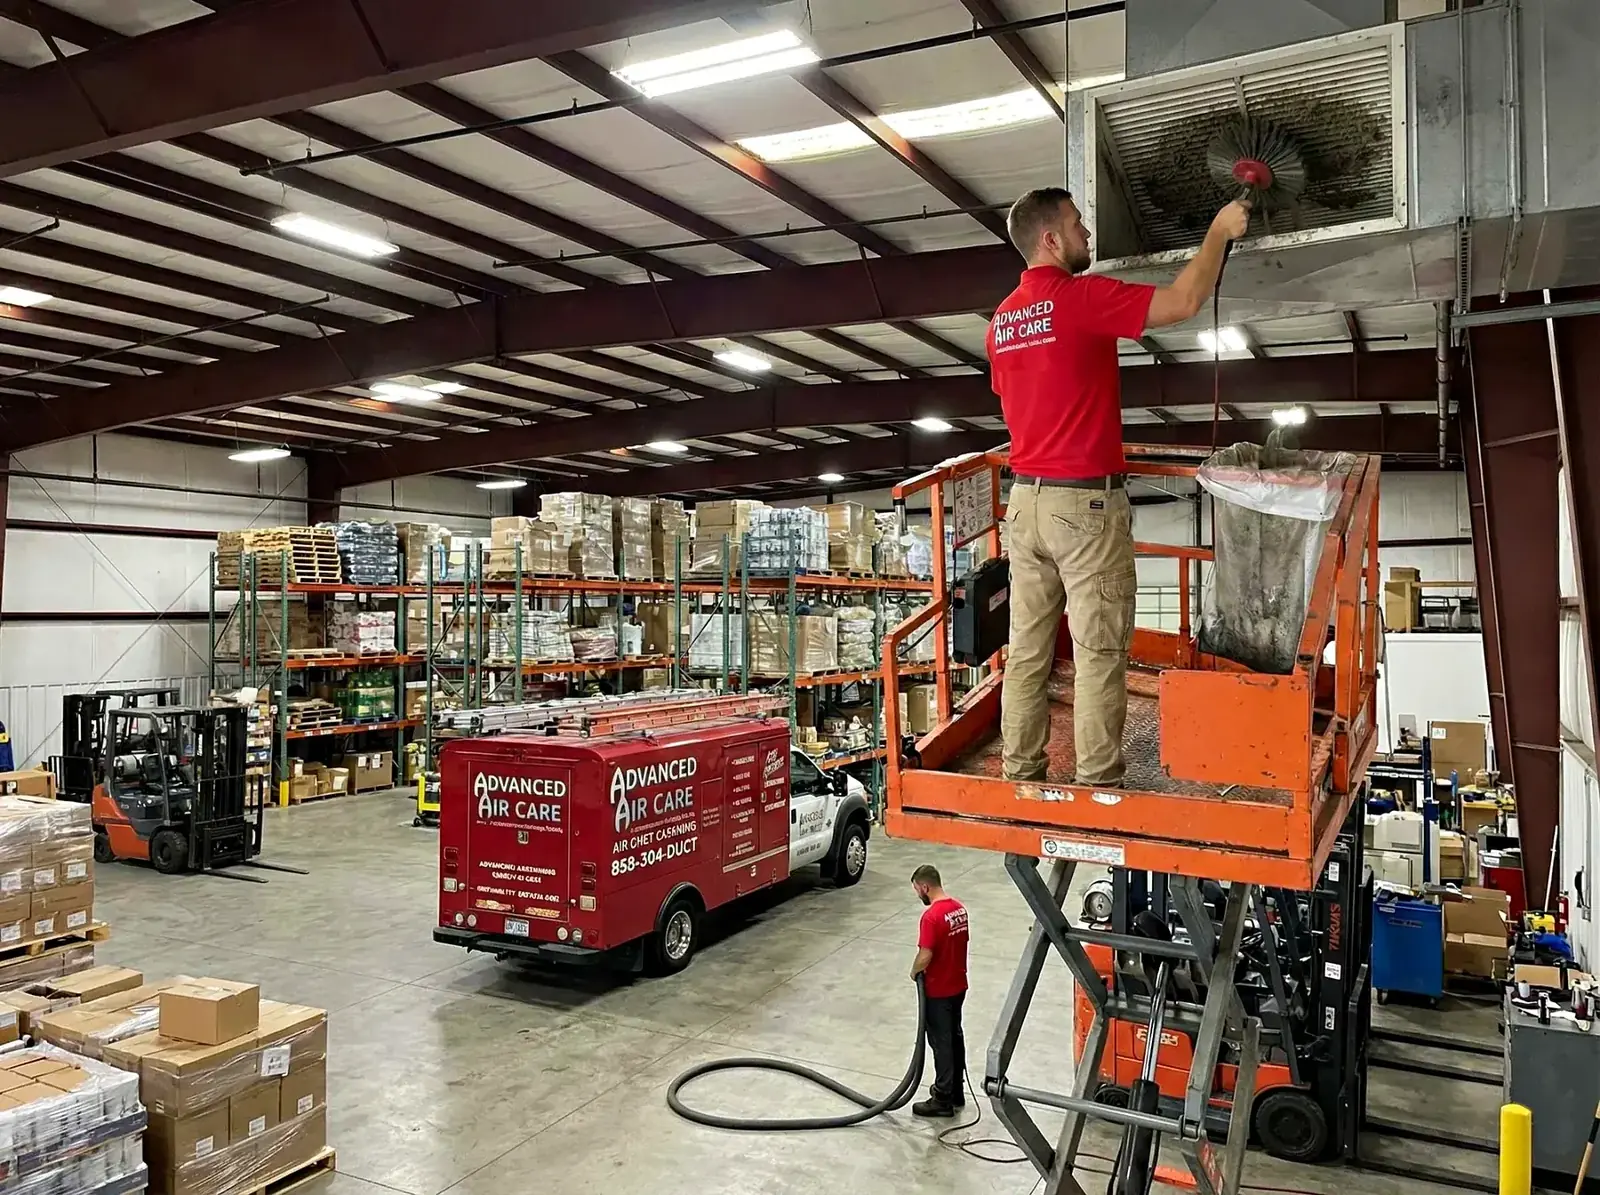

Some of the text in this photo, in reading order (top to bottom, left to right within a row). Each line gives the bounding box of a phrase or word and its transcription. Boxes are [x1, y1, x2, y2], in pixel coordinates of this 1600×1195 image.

[993, 300, 1054, 331] ADVANCED
[995, 325, 1015, 346] AIR
[1018, 317, 1053, 338] CARE
[474, 771, 566, 797] ADVANCED
[610, 756, 697, 804] ADVANCED
[478, 793, 562, 822] AIR CARE
[615, 795, 648, 833] AIR
[653, 786, 694, 815] CARE
[611, 836, 698, 876] 858-304-DUCT
[612, 839, 629, 854] AIR
